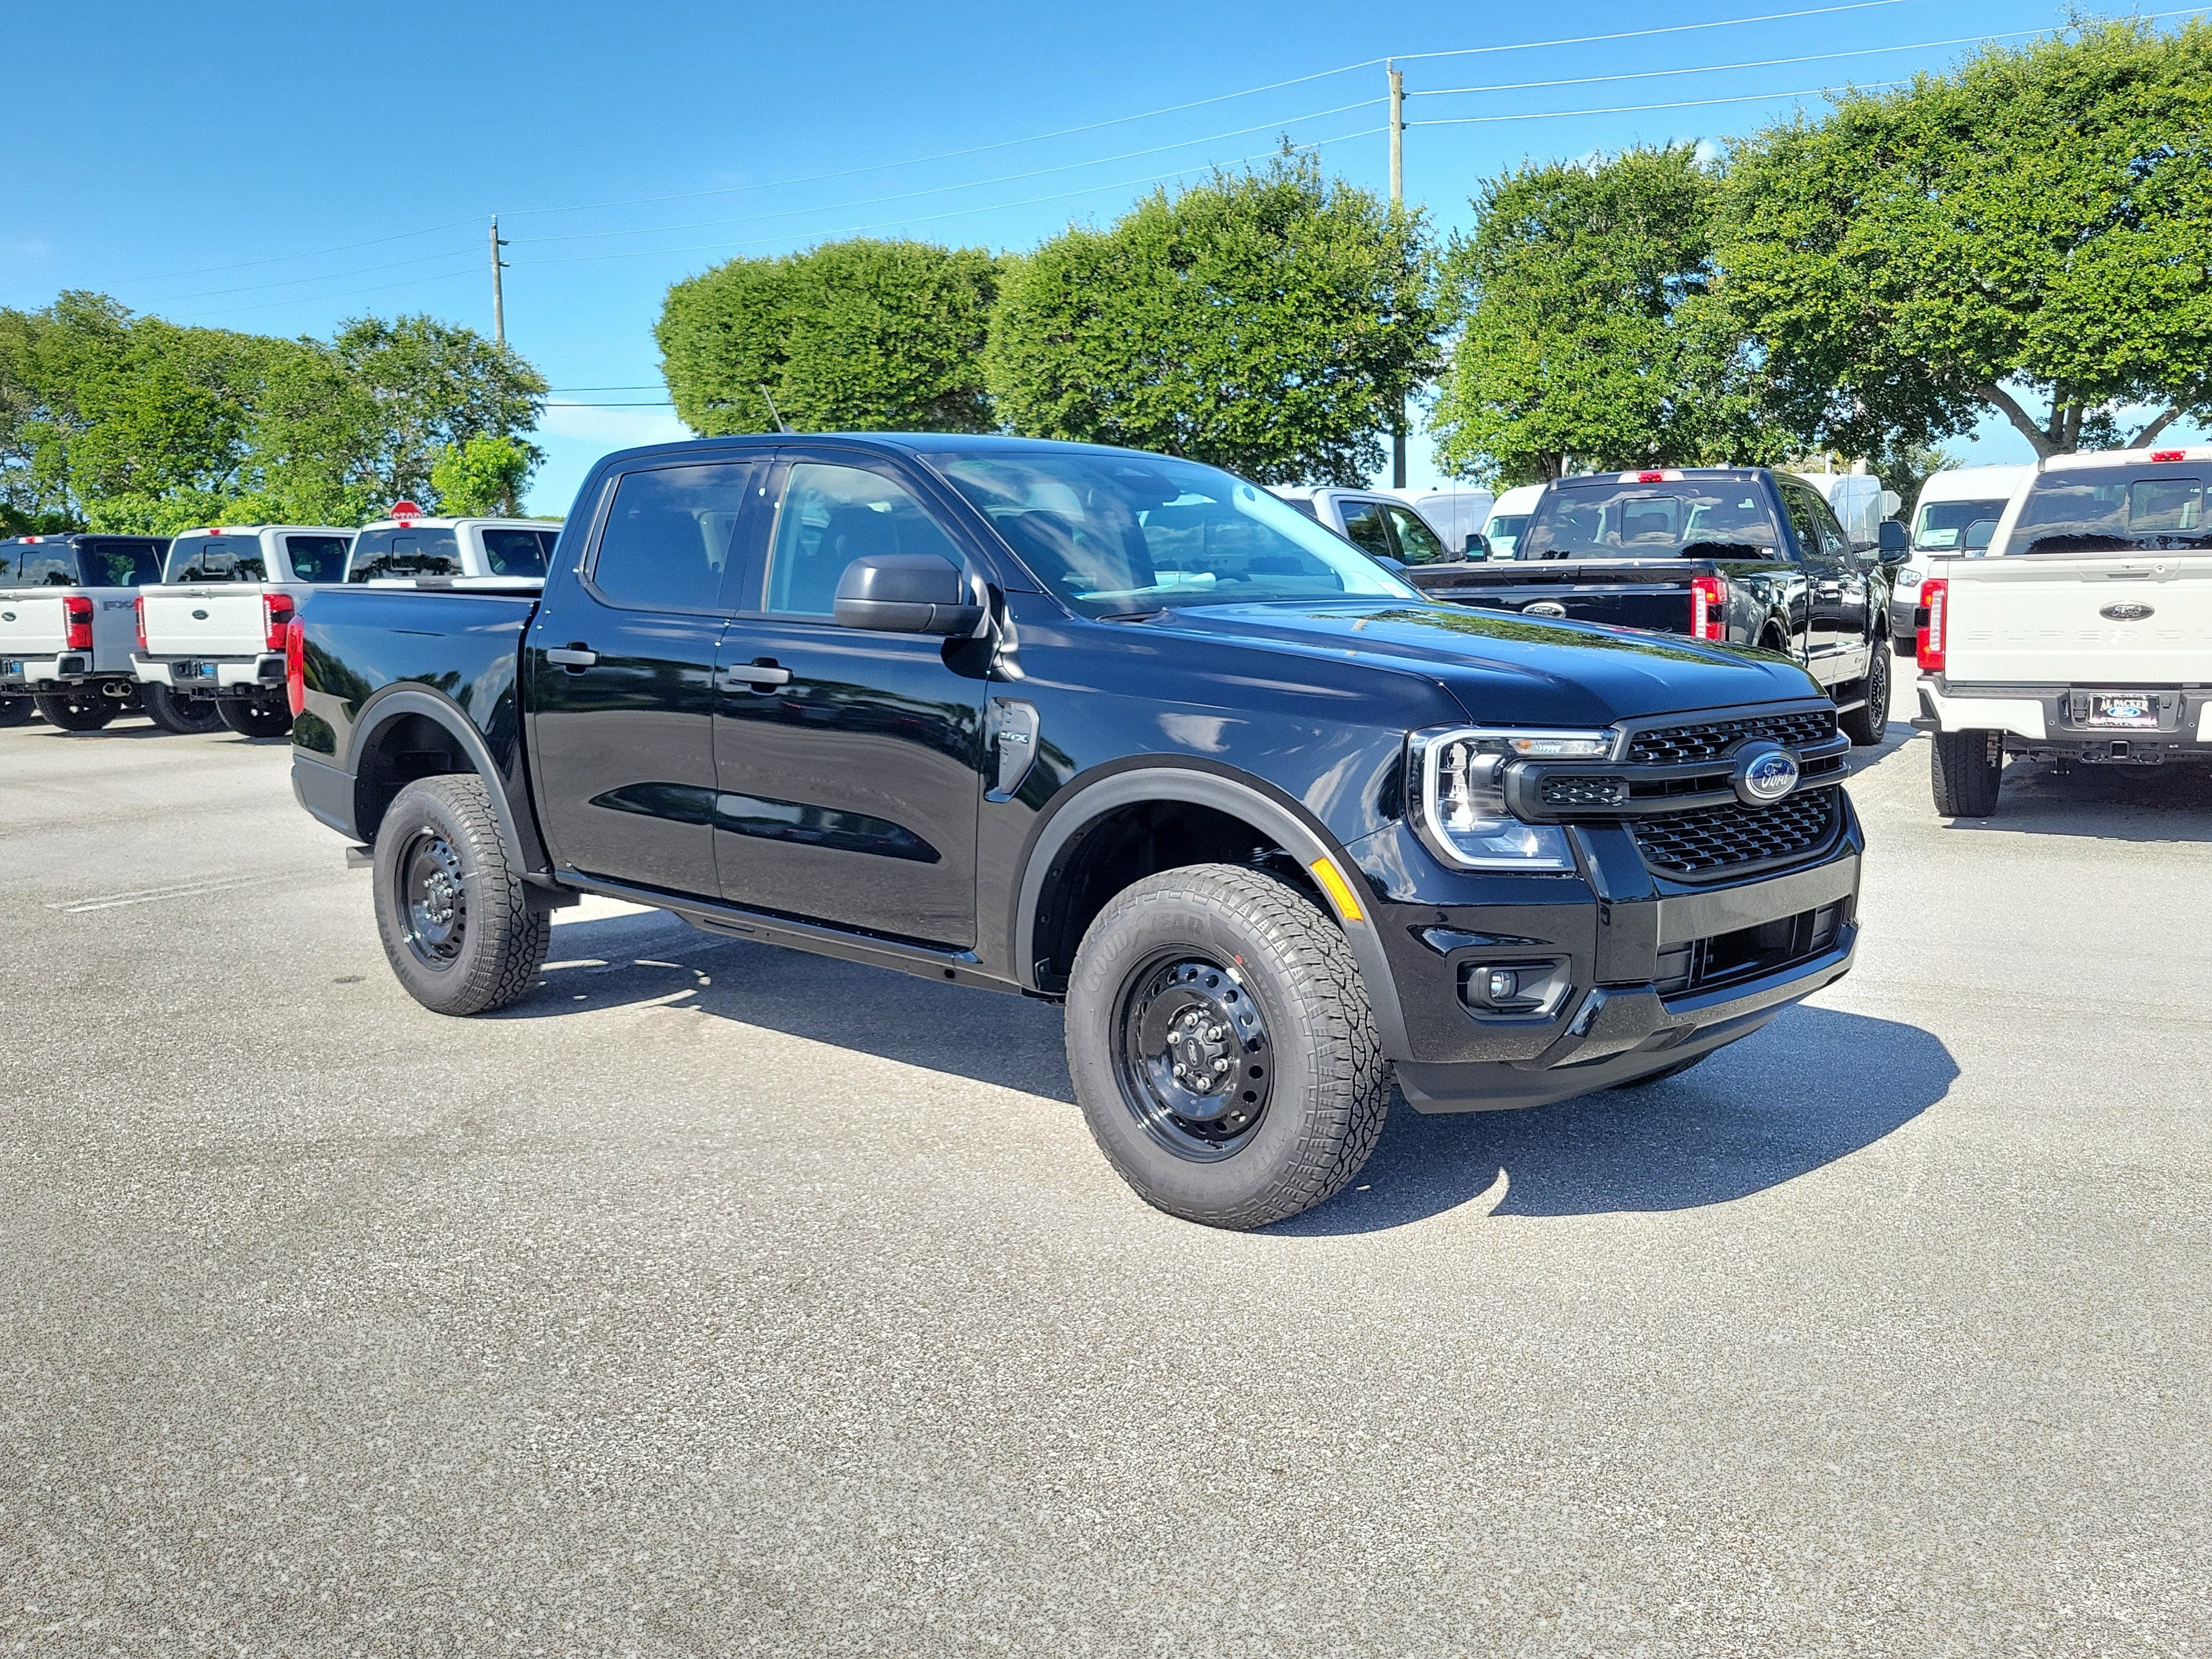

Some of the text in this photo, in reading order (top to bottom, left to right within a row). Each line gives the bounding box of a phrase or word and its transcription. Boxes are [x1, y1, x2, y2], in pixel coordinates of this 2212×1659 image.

[1967, 630, 2139, 642] SUPER
[2100, 699, 2149, 713] AL PACKER
[1762, 763, 1790, 788] Ford
[1087, 912, 1204, 992] GOODYEAR
